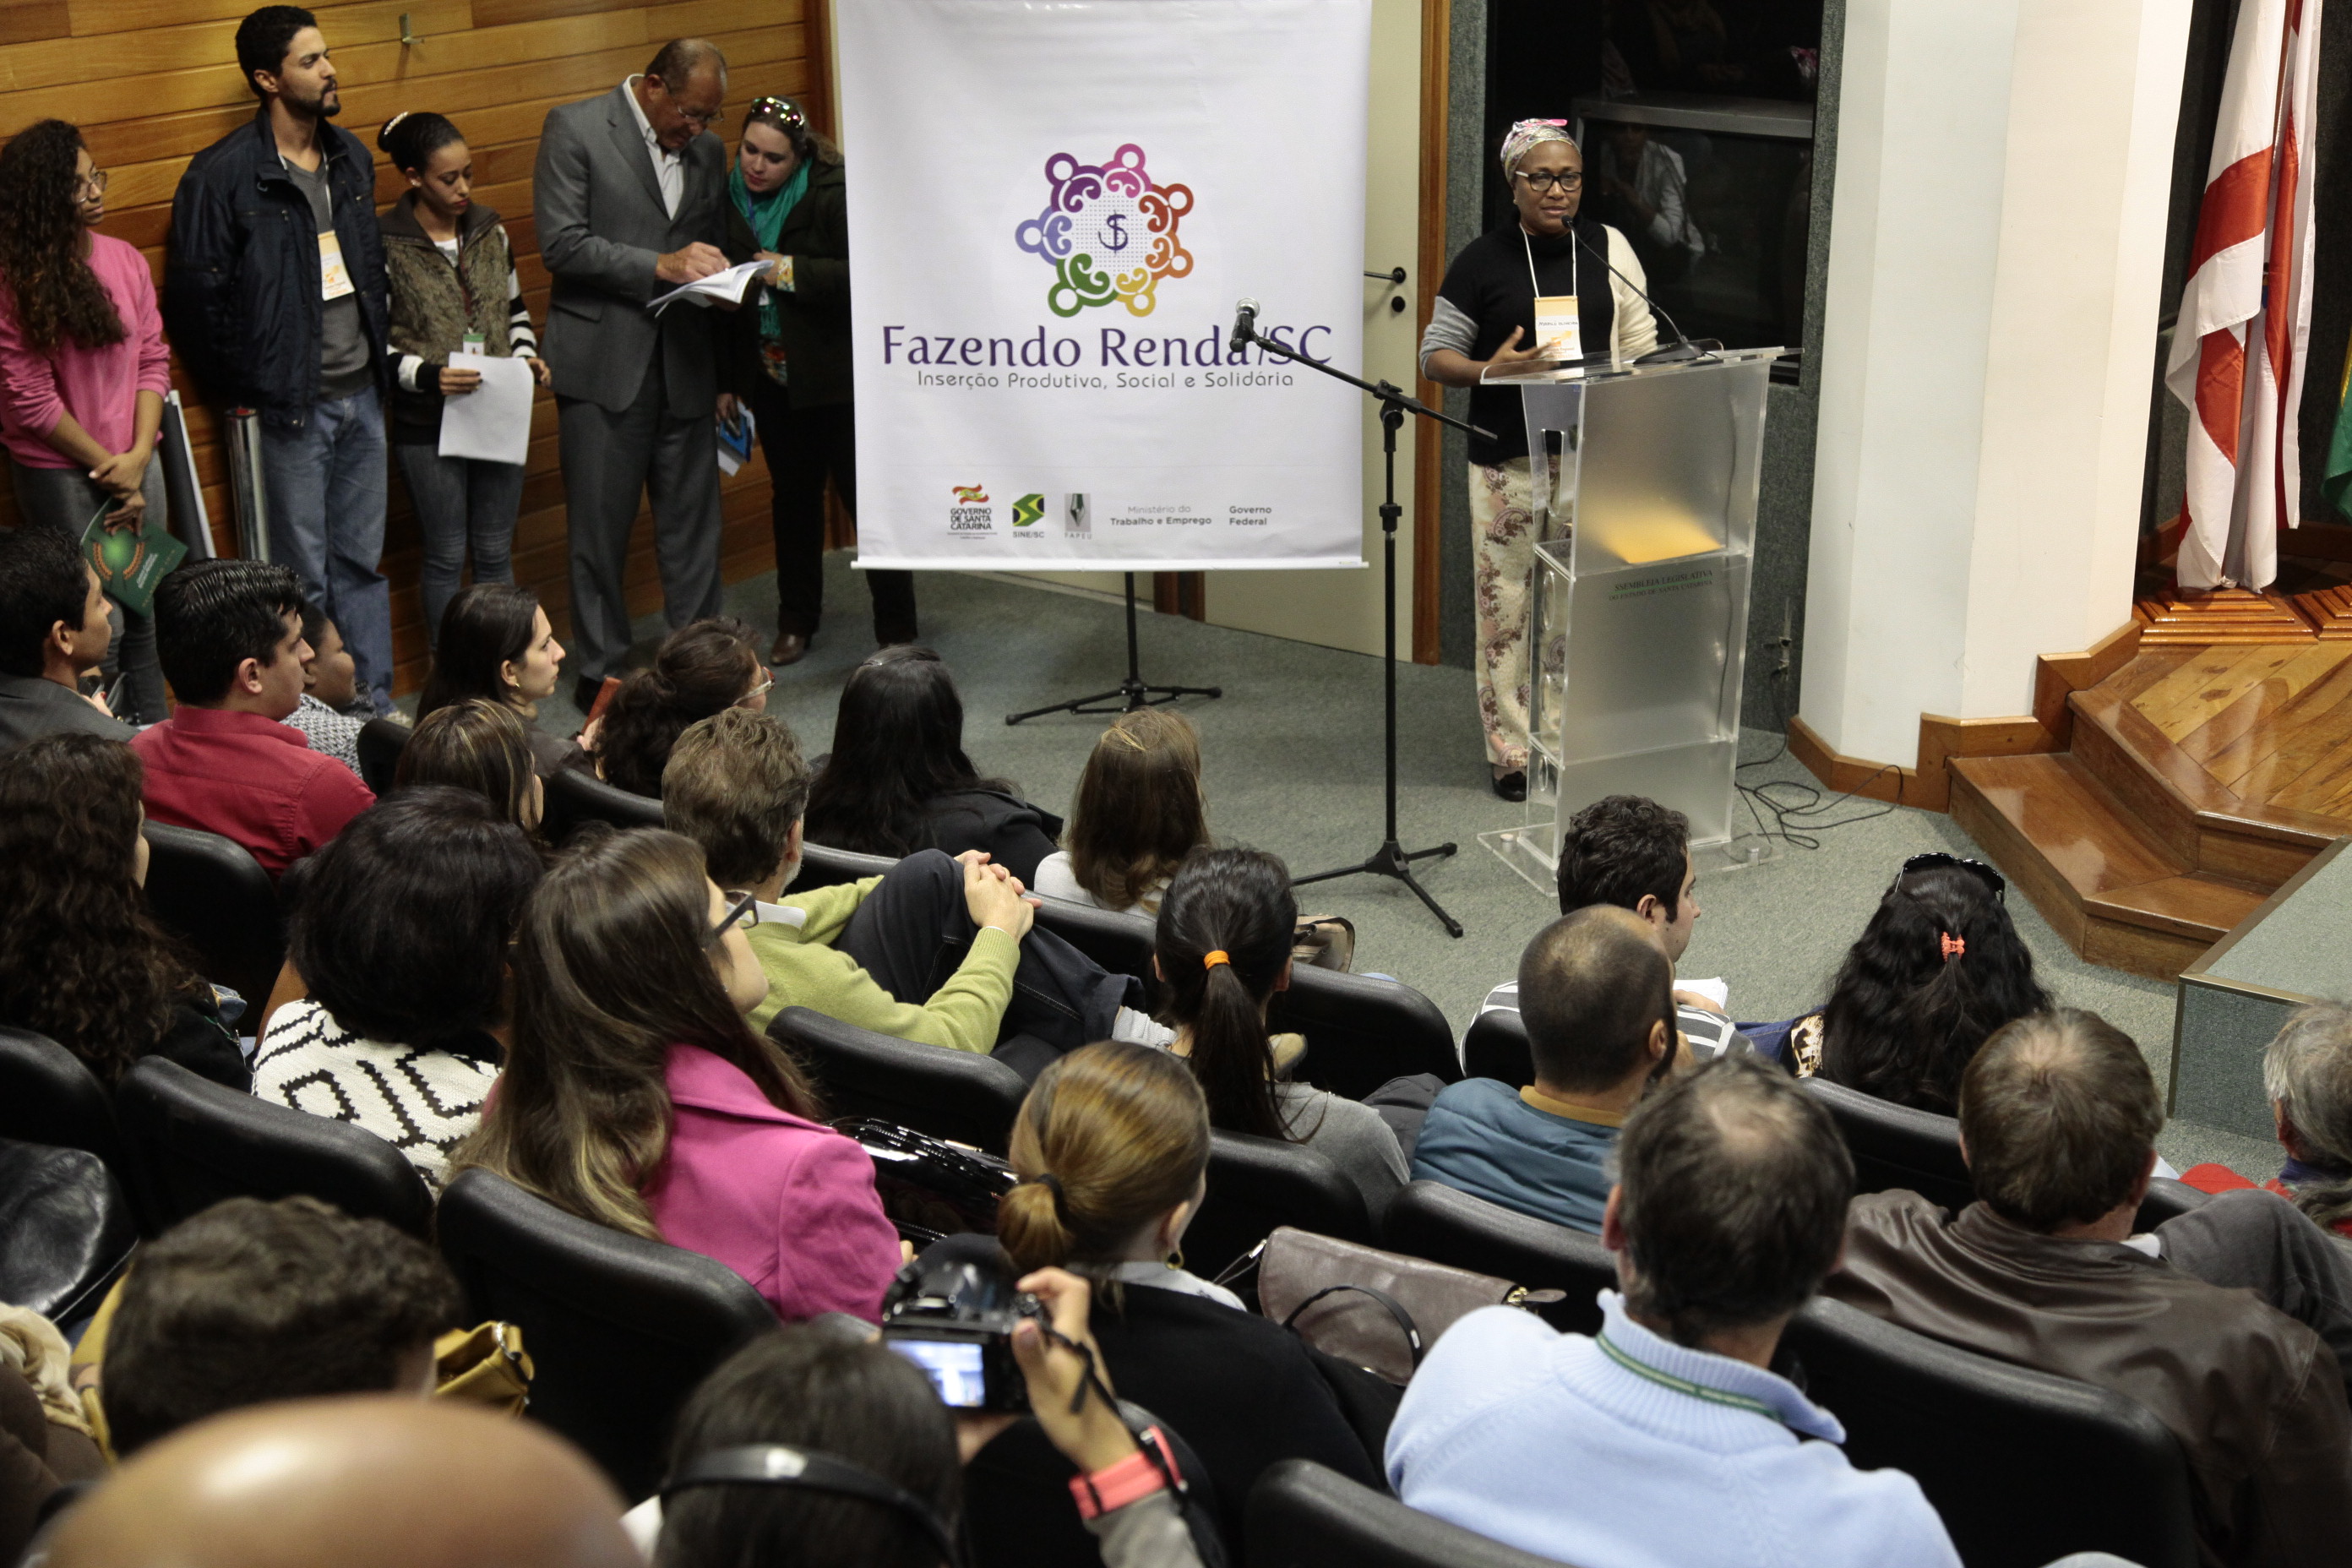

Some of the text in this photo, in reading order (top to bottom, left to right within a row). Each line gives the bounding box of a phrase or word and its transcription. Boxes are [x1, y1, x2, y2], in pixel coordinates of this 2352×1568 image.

[883, 325, 1081, 367] Fazendo
[917, 370, 1293, 389] Inserção Produtiva, Social e Solidária
[950, 508, 992, 516] GOVERNO
[1127, 504, 1191, 515] Ministério do
[1228, 505, 1272, 514] Governo
[1110, 516, 1153, 526] Trabalho
[1166, 516, 1212, 527] Emprego
[1228, 516, 1267, 525] Federal
[1012, 531, 1045, 539] SINE/SC
